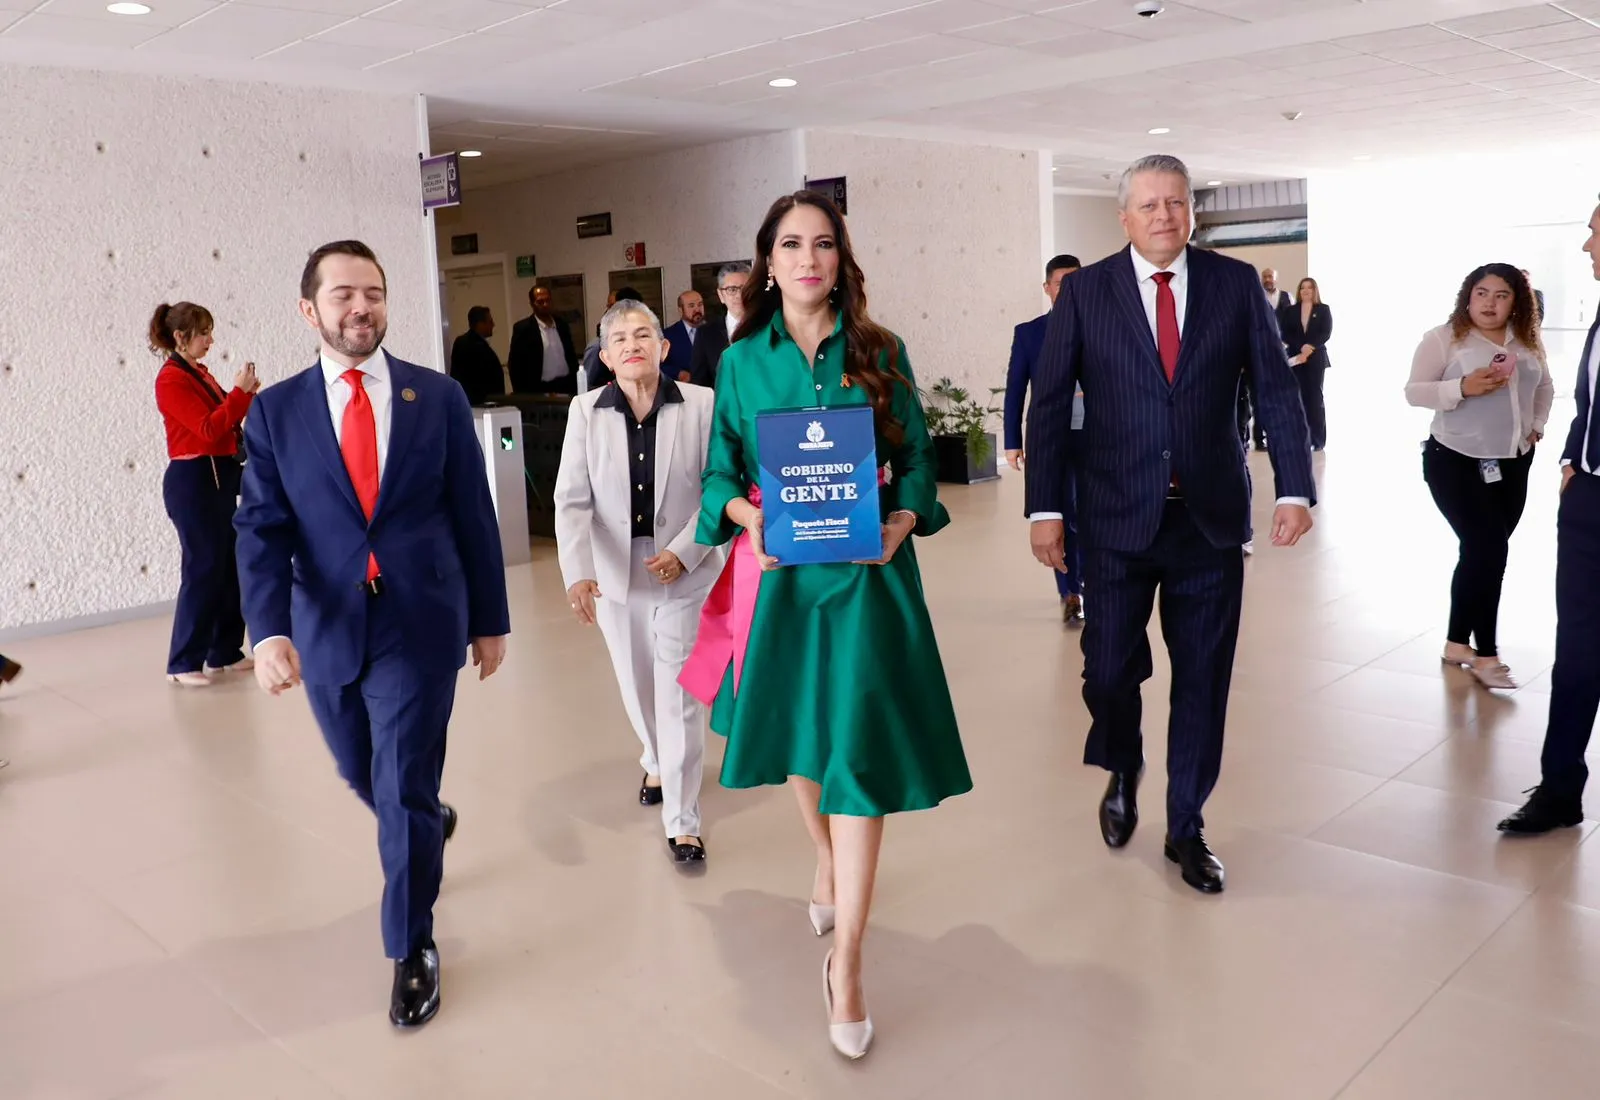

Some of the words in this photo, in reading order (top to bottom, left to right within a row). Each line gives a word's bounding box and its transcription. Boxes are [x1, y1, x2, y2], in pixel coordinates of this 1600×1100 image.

[781, 463, 854, 476] GOBIERNO
[780, 483, 858, 503] GENTE
[825, 518, 849, 526] Fiscal
